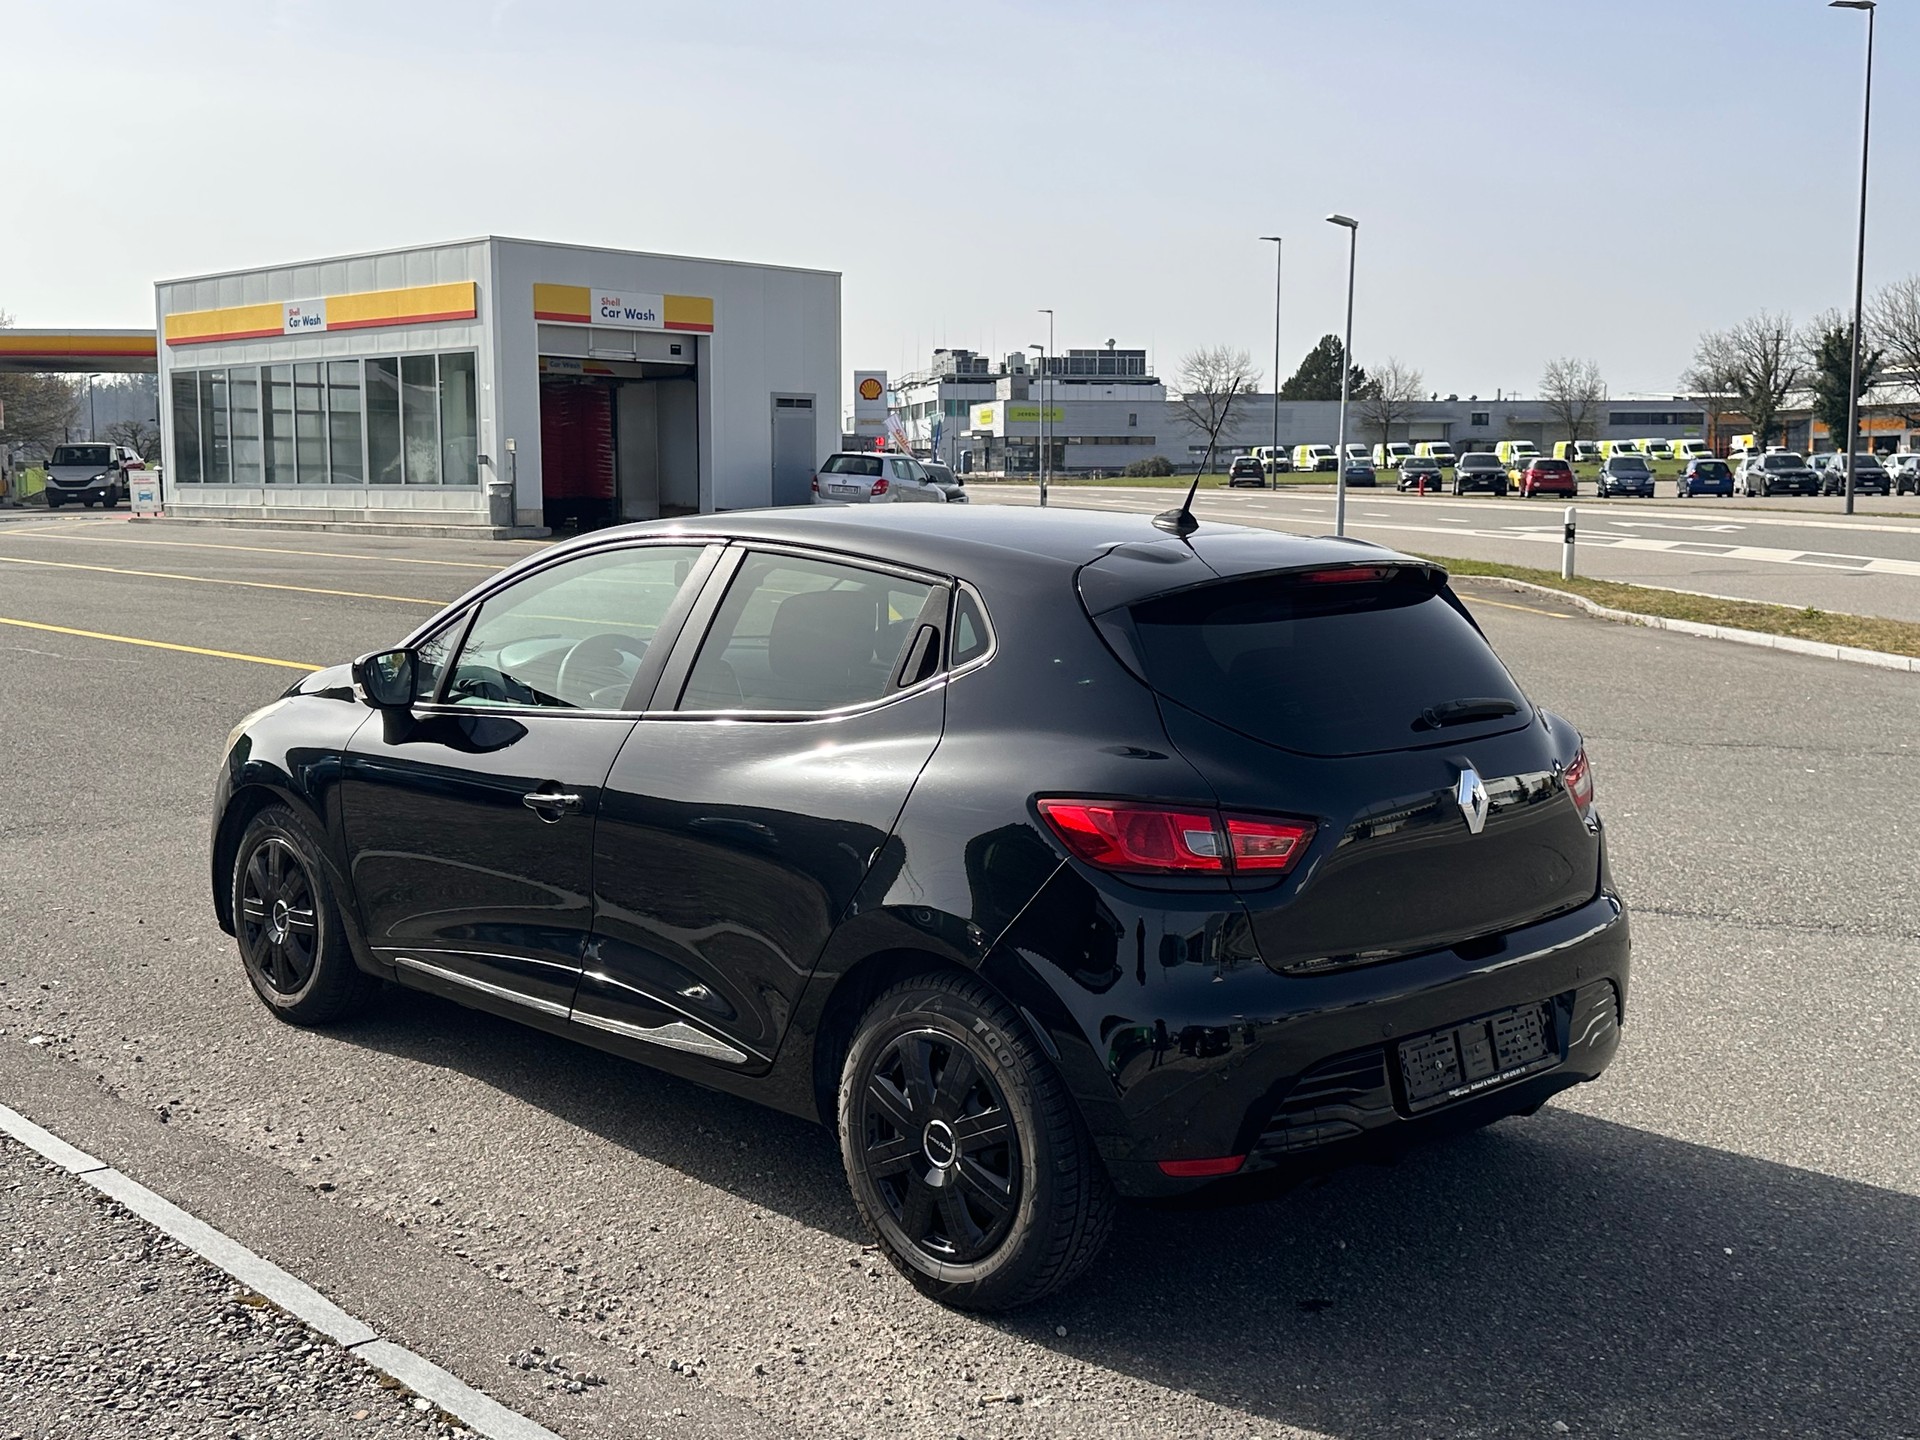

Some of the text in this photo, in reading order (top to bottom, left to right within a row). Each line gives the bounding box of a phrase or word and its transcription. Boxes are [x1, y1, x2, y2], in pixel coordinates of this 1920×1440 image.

[601, 296, 621, 307] Shell
[289, 313, 322, 328] Car Wash
[601, 306, 656, 321] Car Wash
